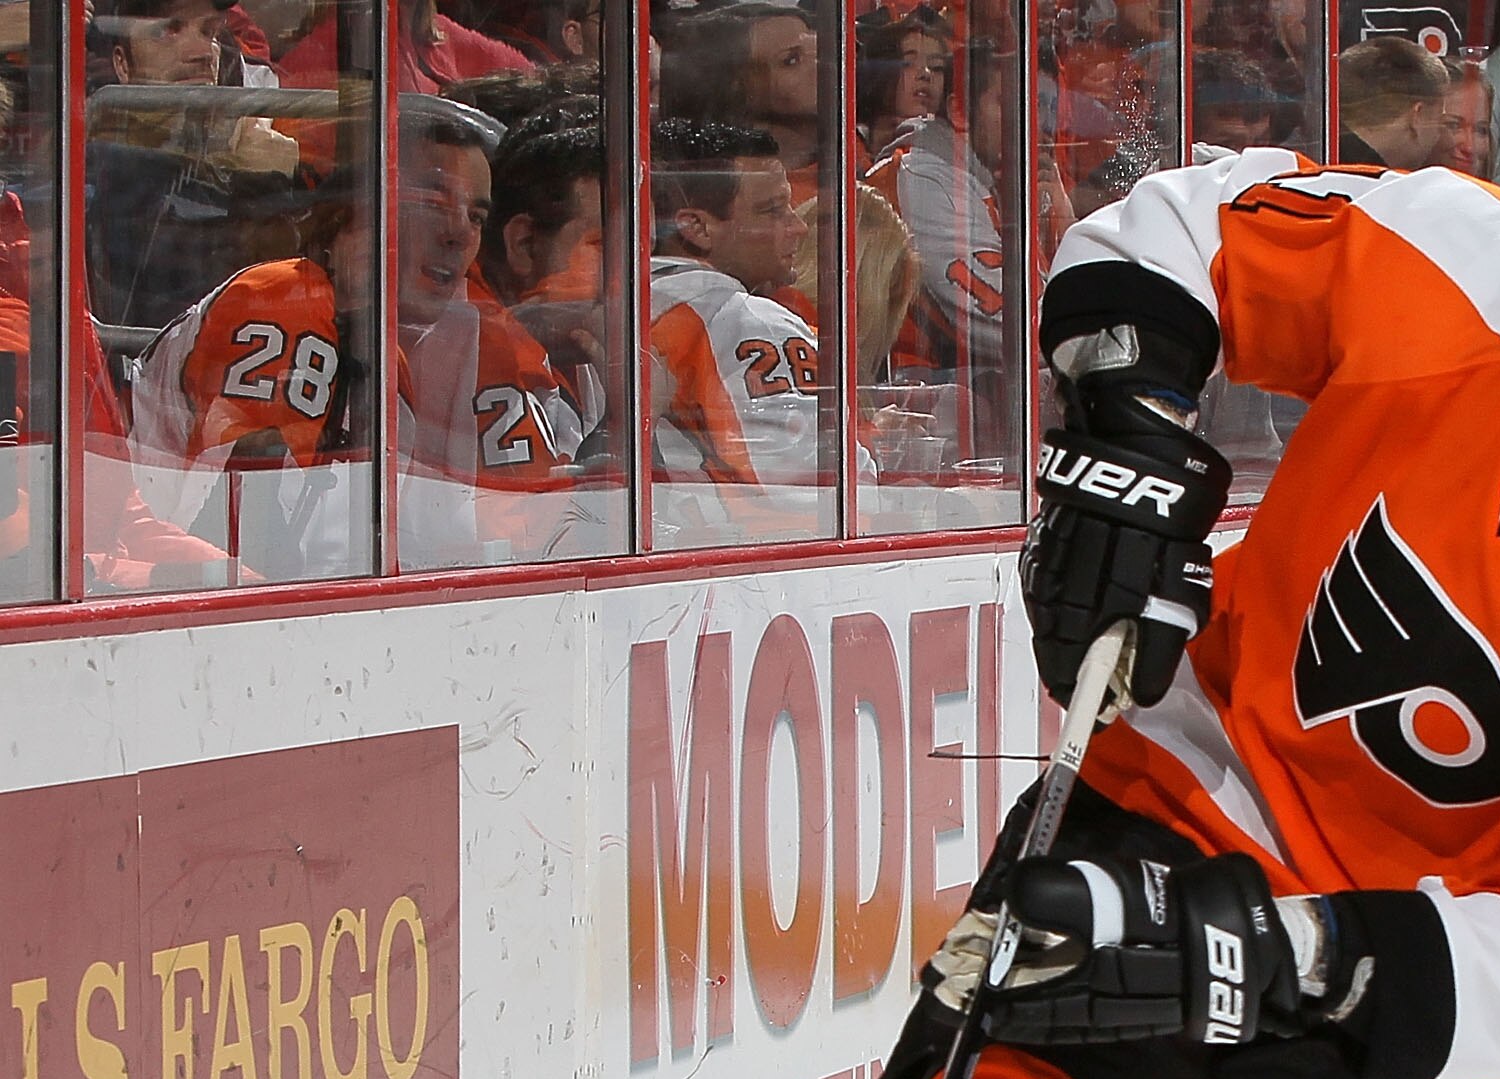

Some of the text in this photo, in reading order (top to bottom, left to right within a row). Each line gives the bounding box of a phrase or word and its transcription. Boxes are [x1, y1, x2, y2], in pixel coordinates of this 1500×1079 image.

[222, 323, 339, 418] 28
[735, 337, 819, 399] 28
[473, 385, 559, 465] 2
